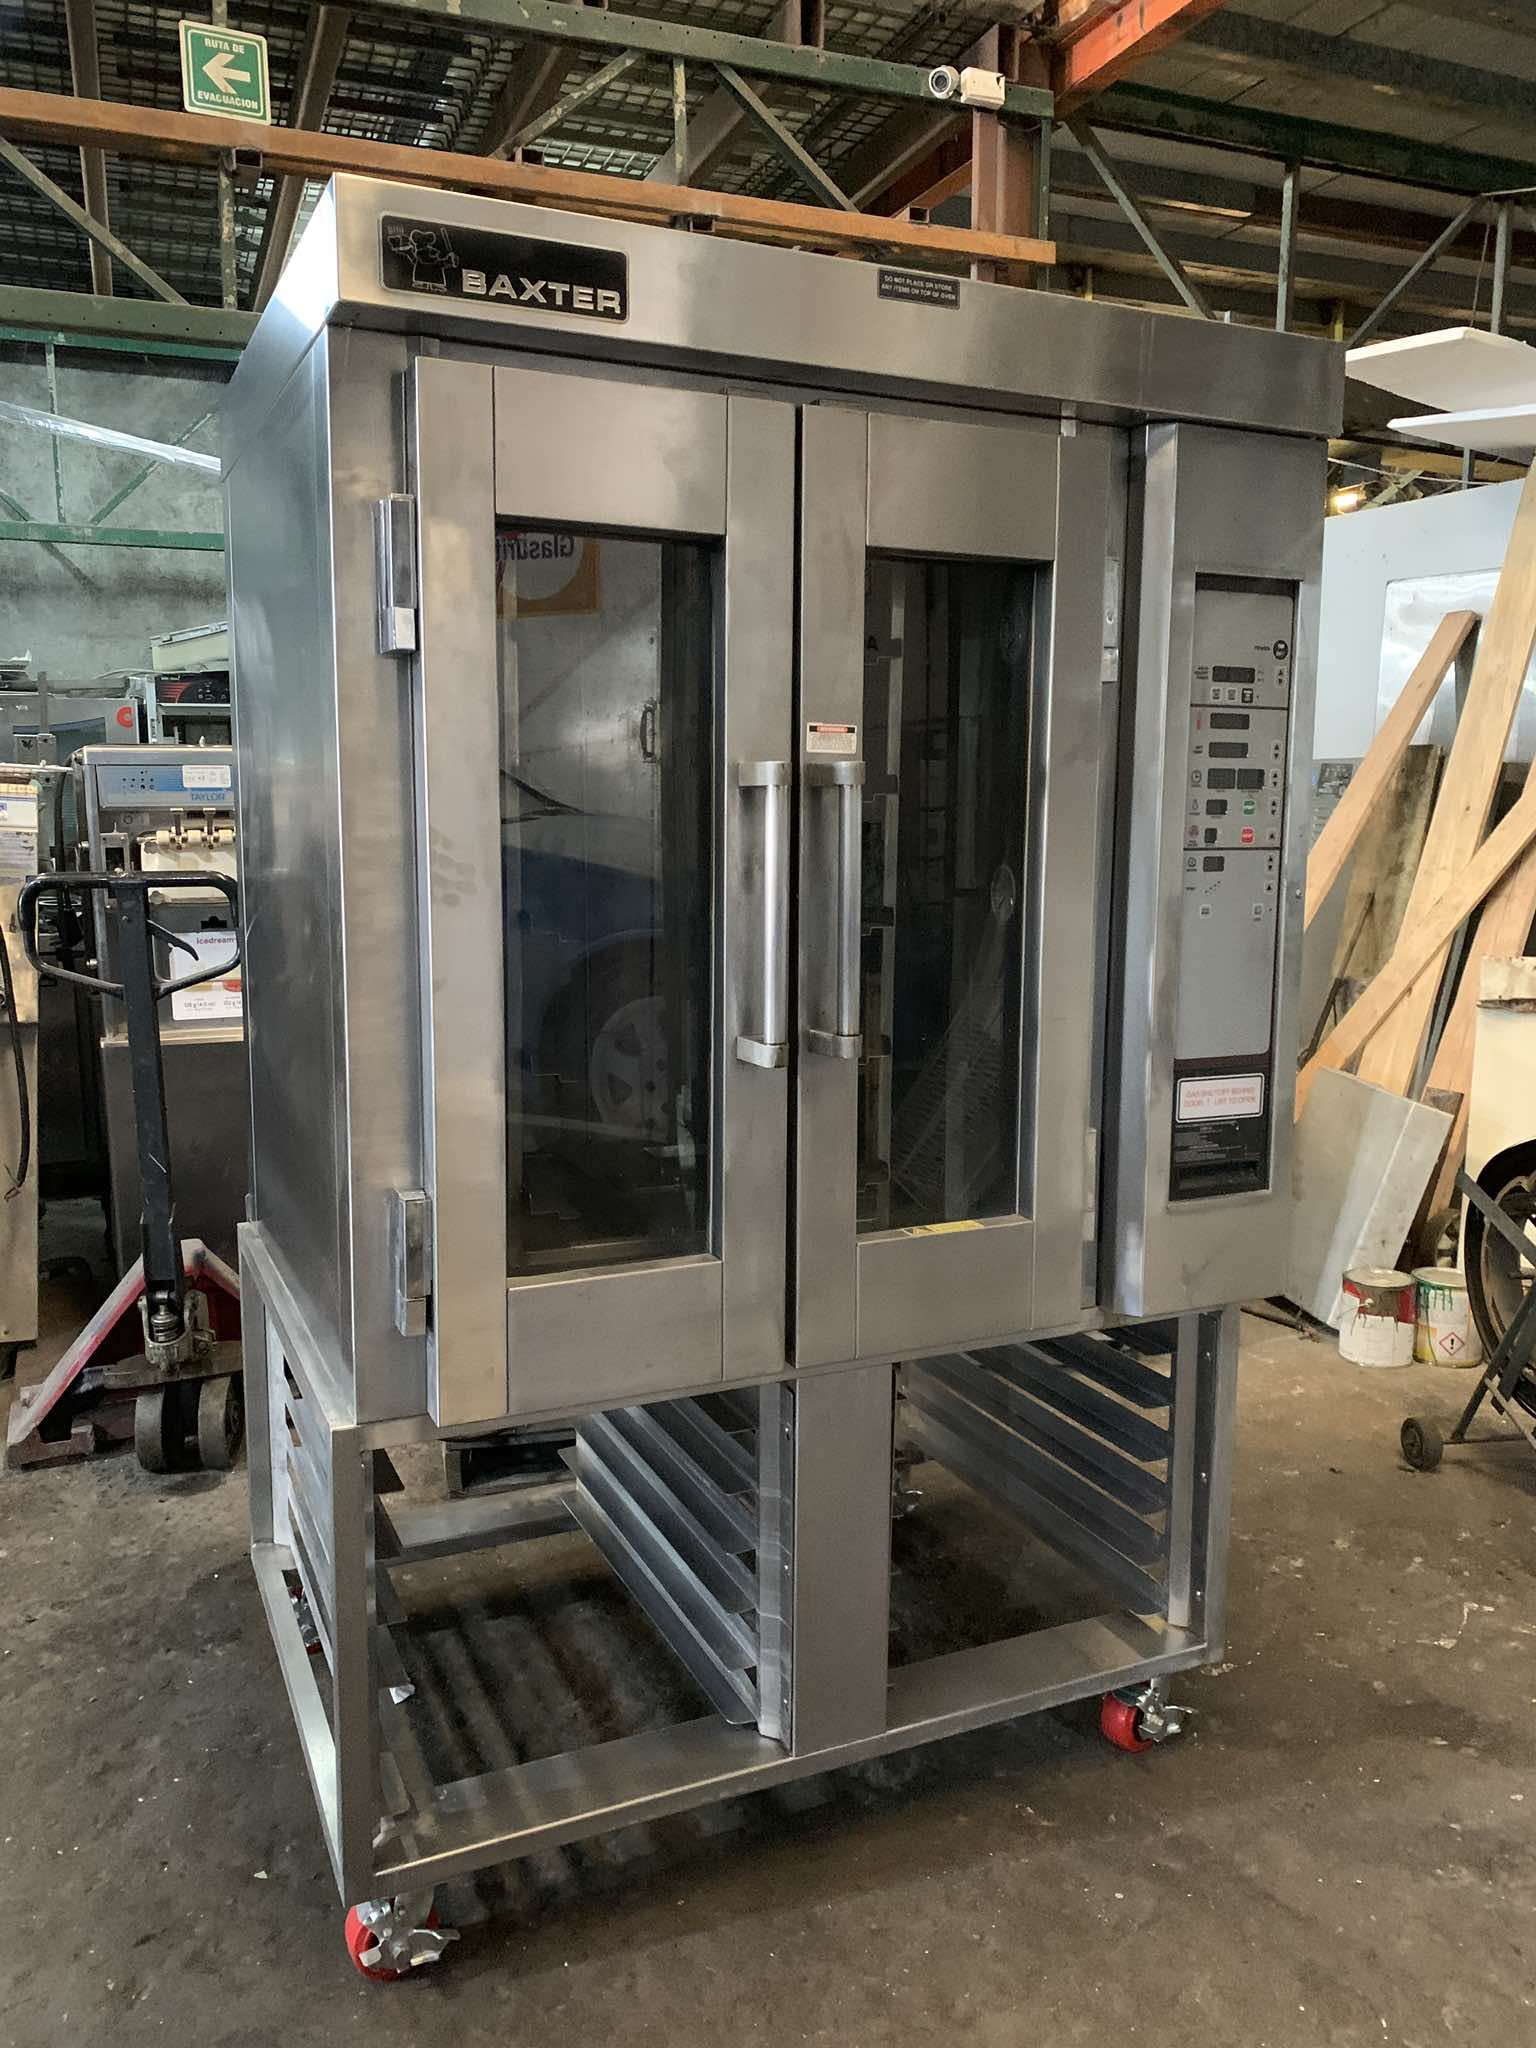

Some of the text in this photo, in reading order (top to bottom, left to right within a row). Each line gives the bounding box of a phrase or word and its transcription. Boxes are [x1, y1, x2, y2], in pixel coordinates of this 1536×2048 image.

[204, 37, 245, 54] RUTA DE
[197, 90, 258, 110] EVACUACION
[461, 268, 622, 314] BAXTER
[893, 285, 910, 293] ITEMS
[911, 287, 920, 295] ON
[920, 289, 931, 297] TOP
[940, 293, 956, 301] OVEN
[906, 279, 924, 288] PLACE
[935, 283, 952, 292] STORE
